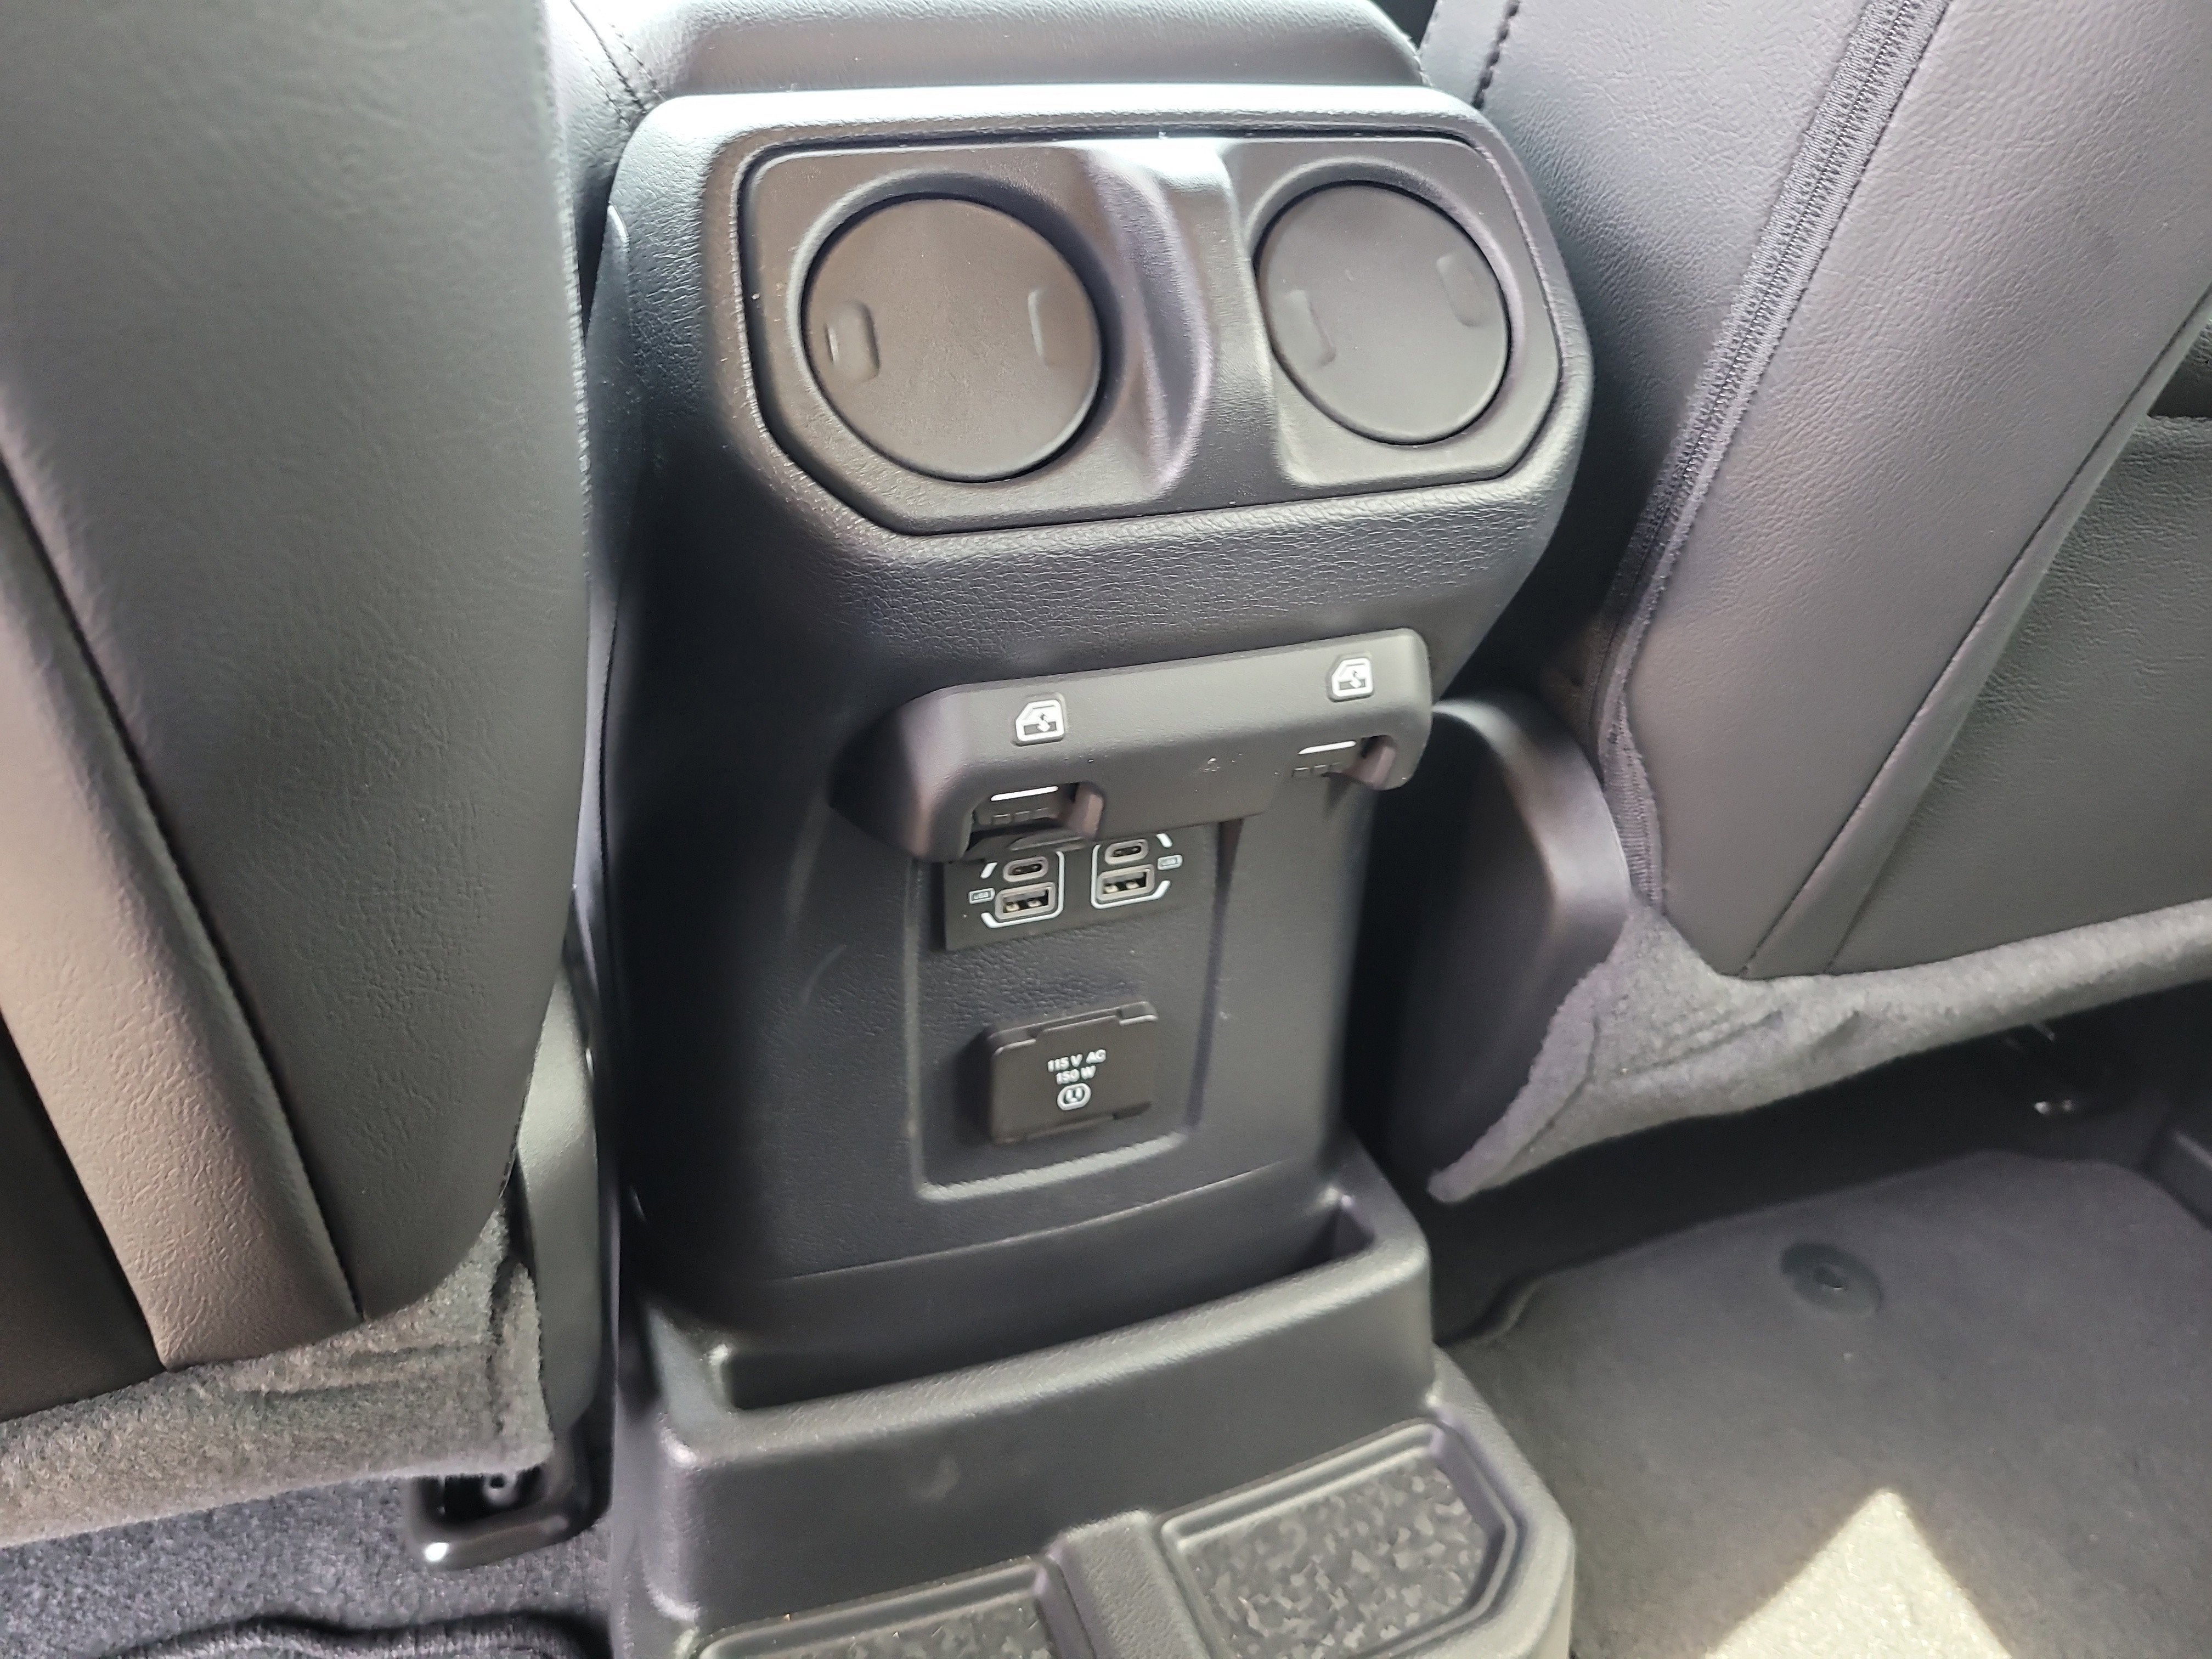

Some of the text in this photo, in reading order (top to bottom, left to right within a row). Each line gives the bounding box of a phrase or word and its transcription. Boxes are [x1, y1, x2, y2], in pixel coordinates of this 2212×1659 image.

[1047, 1049, 1107, 1072] 115 V AC
[1056, 1065, 1096, 1085] 150 W
